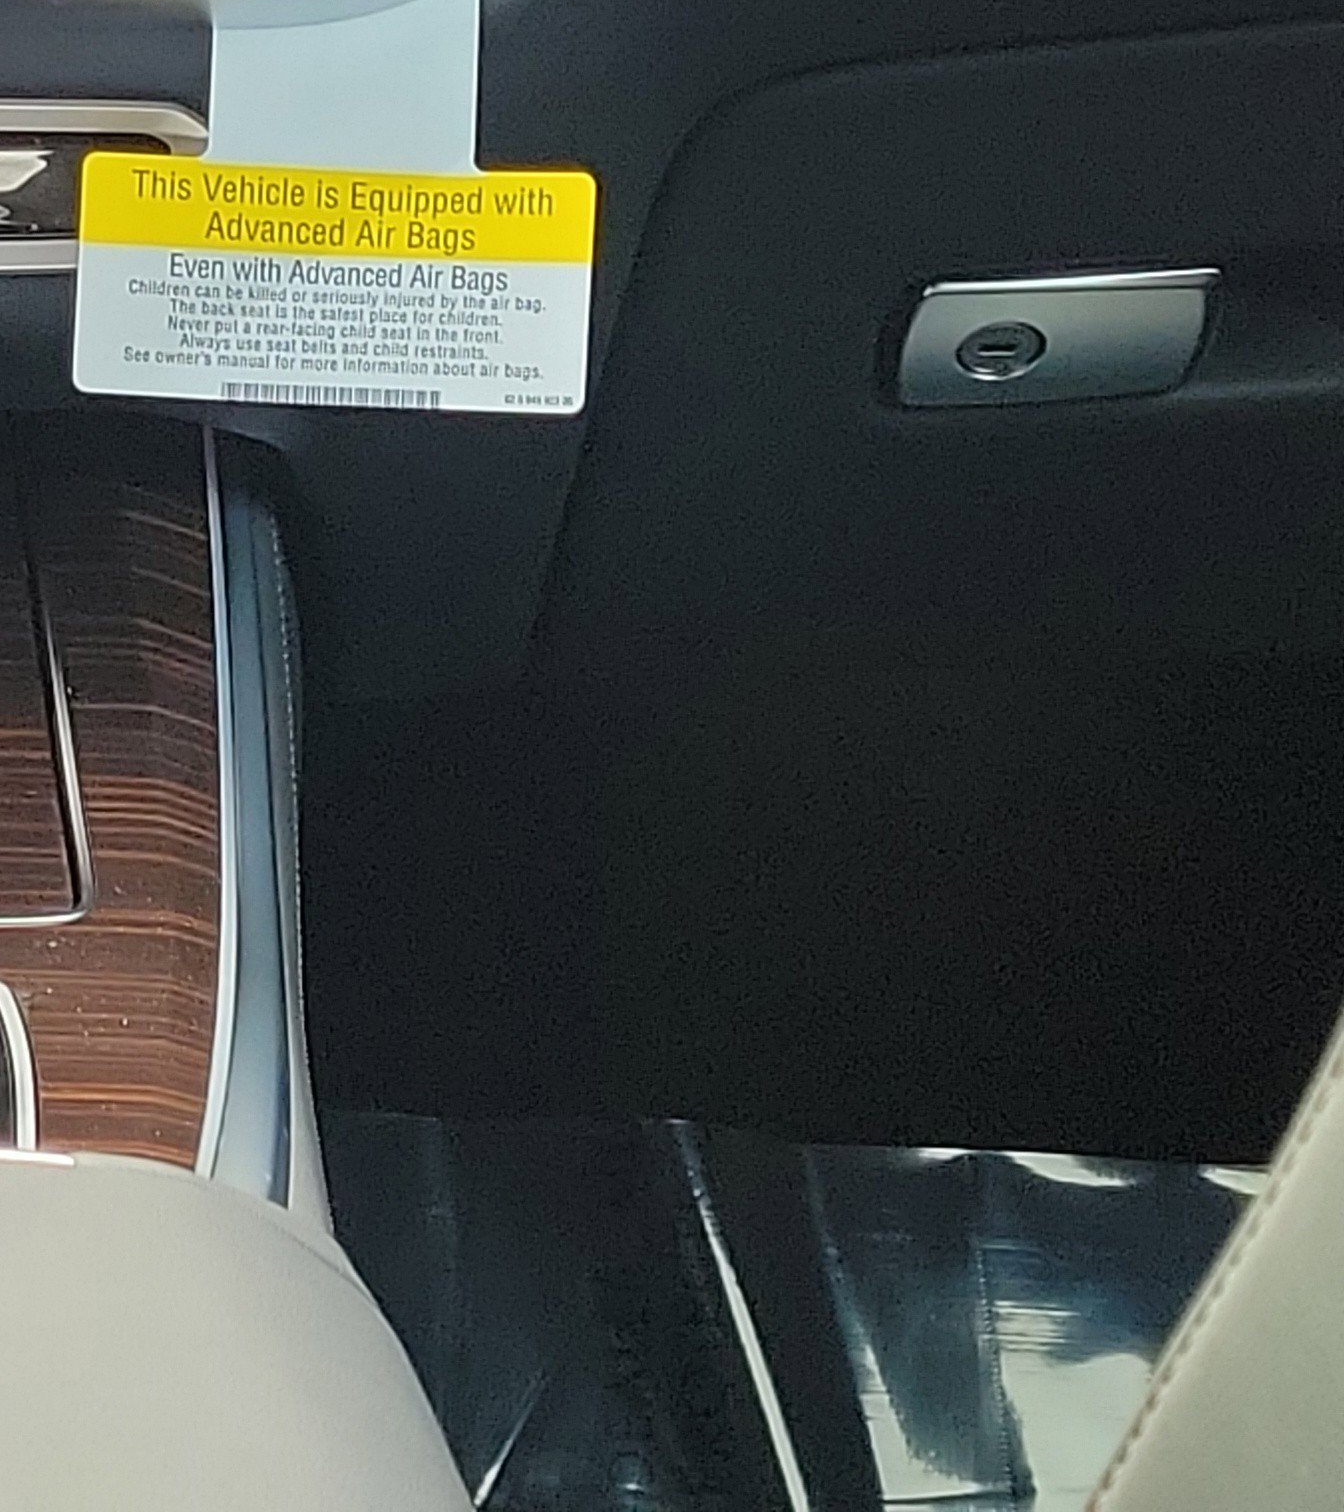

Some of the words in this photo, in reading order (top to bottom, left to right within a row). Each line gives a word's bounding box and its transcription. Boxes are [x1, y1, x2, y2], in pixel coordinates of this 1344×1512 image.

[132, 169, 193, 201] This
[203, 173, 306, 208] Vehicle
[316, 179, 340, 210] is
[351, 181, 483, 220] Equipped
[494, 187, 554, 217] with
[204, 210, 345, 247] Advanced
[355, 219, 397, 249] Air
[407, 220, 476, 257] Bags
[170, 252, 225, 280] Even
[232, 256, 282, 283] with
[288, 259, 403, 288] Advanced
[409, 264, 444, 289] Air
[451, 265, 509, 296] Bags
[128, 278, 190, 299] Children
[194, 284, 220, 299] can
[225, 284, 243, 300] be
[247, 285, 288, 303] killed
[291, 290, 307, 304] or
[311, 290, 379, 309] seriously
[383, 292, 436, 311] injured
[440, 293, 459, 312] by
[463, 295, 486, 311] the
[490, 296, 511, 311] air
[514, 296, 547, 315] bag.
[170, 298, 197, 314] The
[201, 300, 235, 317] back
[240, 303, 271, 318] seat
[275, 304, 288, 319] is
[292, 305, 316, 320] the
[320, 305, 365, 323] safest
[369, 308, 408, 326] place
[413, 309, 434, 325] for
[438, 310, 504, 328] children.
[167, 315, 210, 333] Never
[214, 320, 239, 338] put
[242, 322, 252, 335] a
[256, 321, 336, 340] rear-facing
[340, 325, 376, 340] child
[380, 326, 411, 341] seat
[416, 327, 431, 341] in
[435, 328, 459, 343] the
[463, 328, 504, 345] front.
[179, 333, 232, 353] Always
[236, 337, 262, 352] use
[266, 337, 297, 353] seat
[301, 338, 337, 355] belts
[341, 341, 369, 356] and
[373, 341, 409, 358] child
[414, 344, 489, 361] restraints.
[124, 345, 151, 363] See
[155, 351, 212, 367] owner's
[217, 353, 270, 370] manual
[275, 354, 297, 371] for
[300, 356, 339, 372] more
[343, 358, 429, 376] information
[433, 361, 476, 378] about
[479, 363, 500, 379] air
[504, 363, 544, 382] bags.
